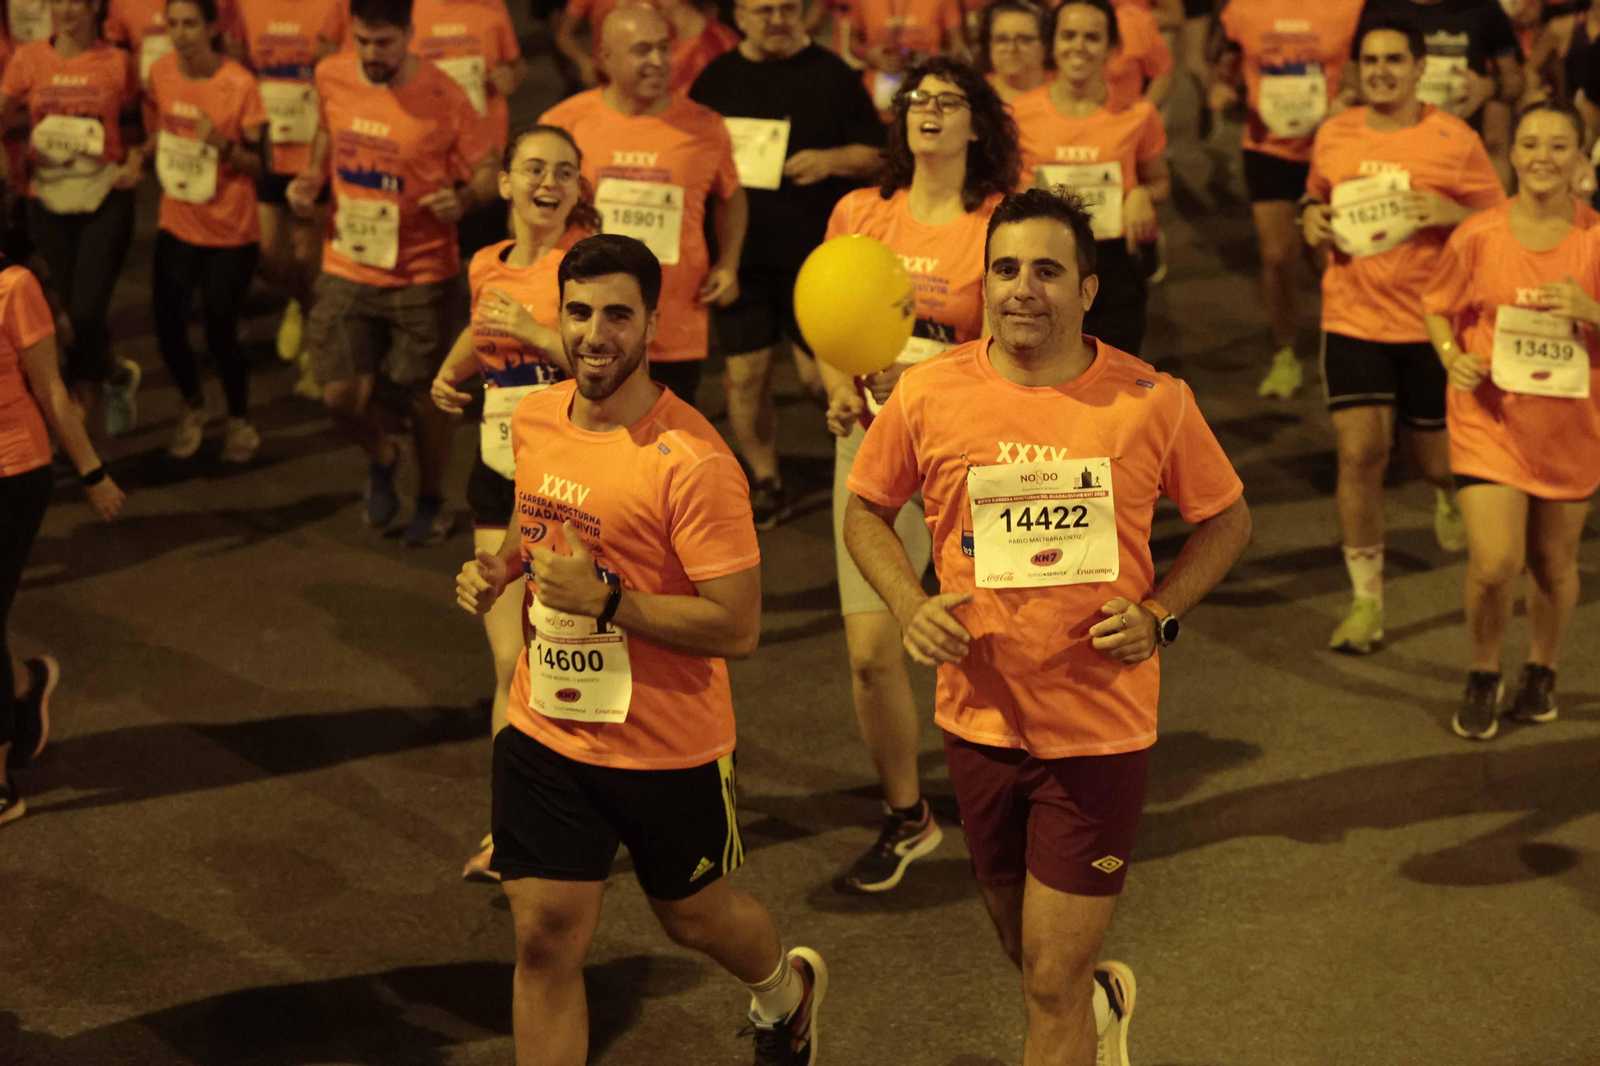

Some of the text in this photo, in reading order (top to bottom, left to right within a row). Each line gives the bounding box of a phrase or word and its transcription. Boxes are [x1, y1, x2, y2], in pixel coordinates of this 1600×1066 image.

[613, 209, 664, 229] 18901
[1513, 339, 1574, 361] 13439
[995, 441, 1068, 464] XXXV
[537, 473, 591, 506] XXXV
[518, 491, 553, 508] CARRERA
[556, 503, 602, 526] NOCTURNA
[521, 503, 601, 539] GUADALUIVIR
[1000, 505, 1089, 533] 14422
[1008, 537, 1029, 545] PABLO
[1076, 568, 1113, 576] Cruzcampo
[537, 643, 604, 673] 14600
